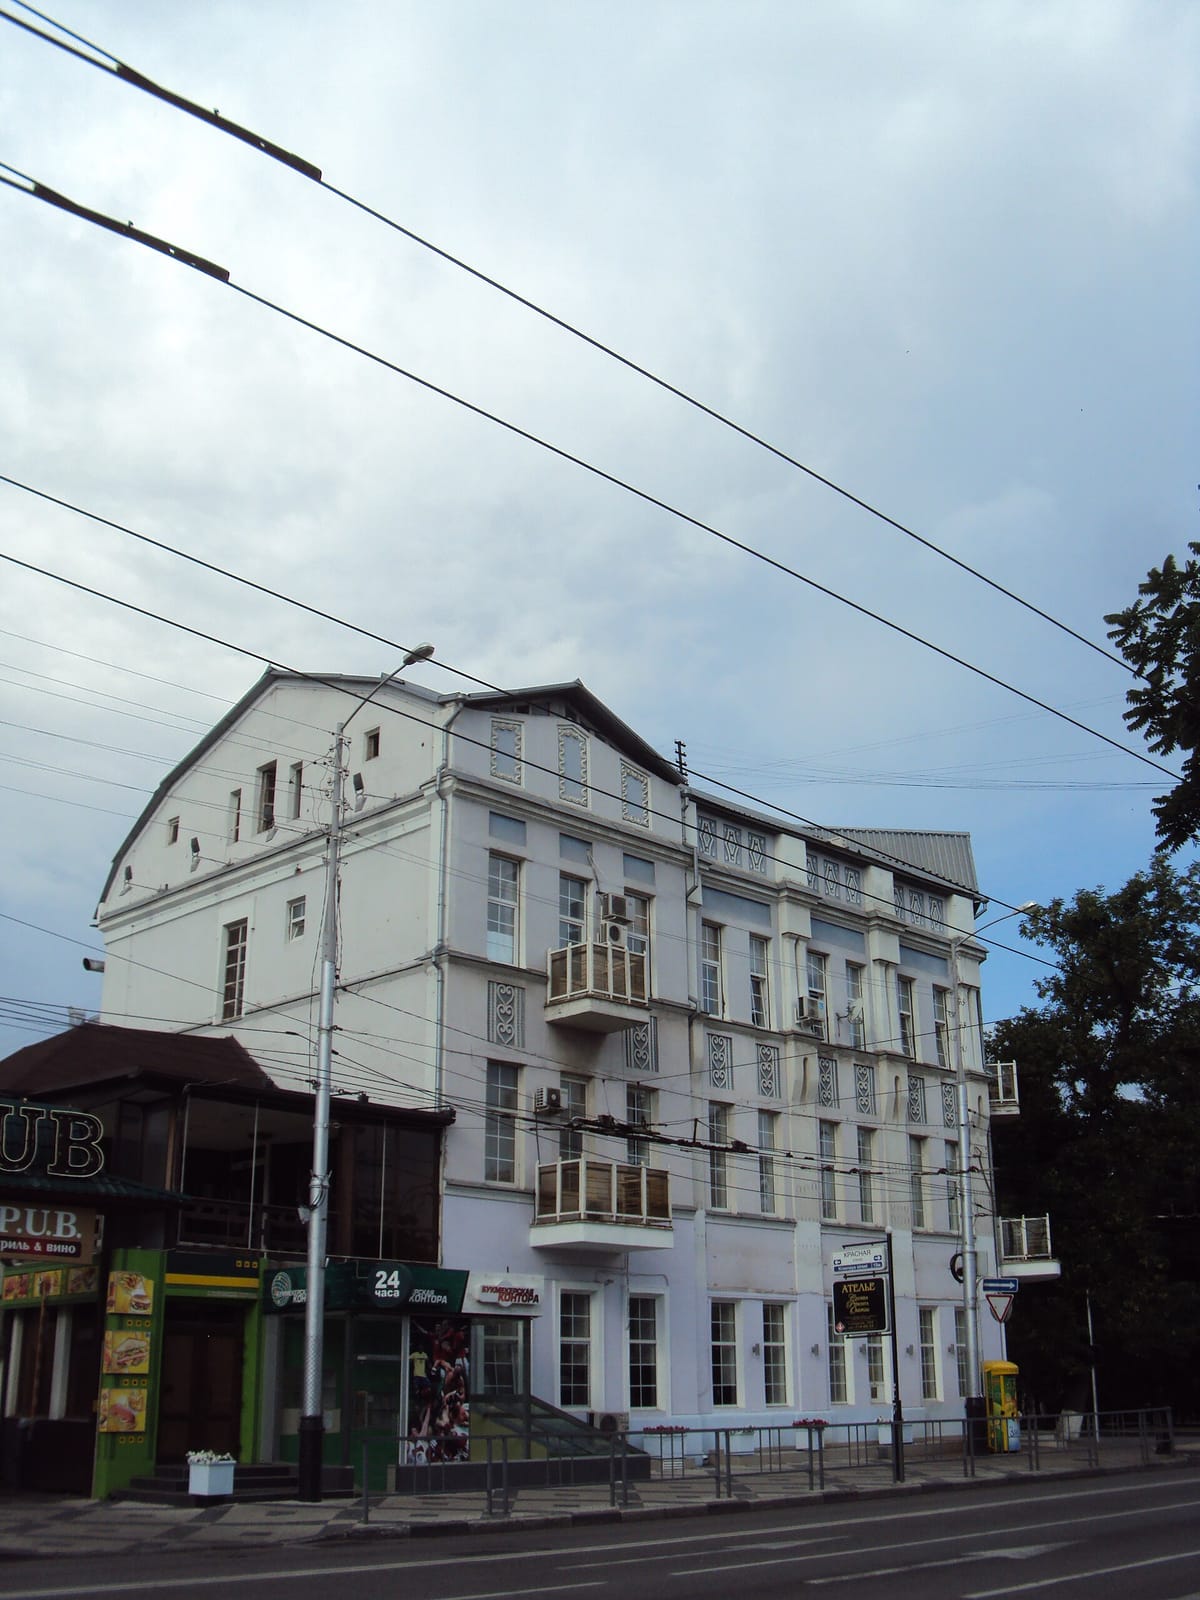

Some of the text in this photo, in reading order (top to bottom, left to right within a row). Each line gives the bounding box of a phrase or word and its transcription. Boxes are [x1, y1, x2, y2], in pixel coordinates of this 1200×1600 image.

[0, 1206, 82, 1239] P.U.B.
[34, 1241, 42, 1252] &
[46, 1243, 76, 1254] вино
[843, 1249, 871, 1257] КРАСНАЯ
[375, 1270, 400, 1289] 24
[375, 1289, 399, 1298] часа
[481, 1285, 534, 1295] БУКМЕКЕРСКАЯ
[842, 1282, 876, 1294] АТЕЛЬЕ
[498, 1292, 539, 1303] КОНТОРА
